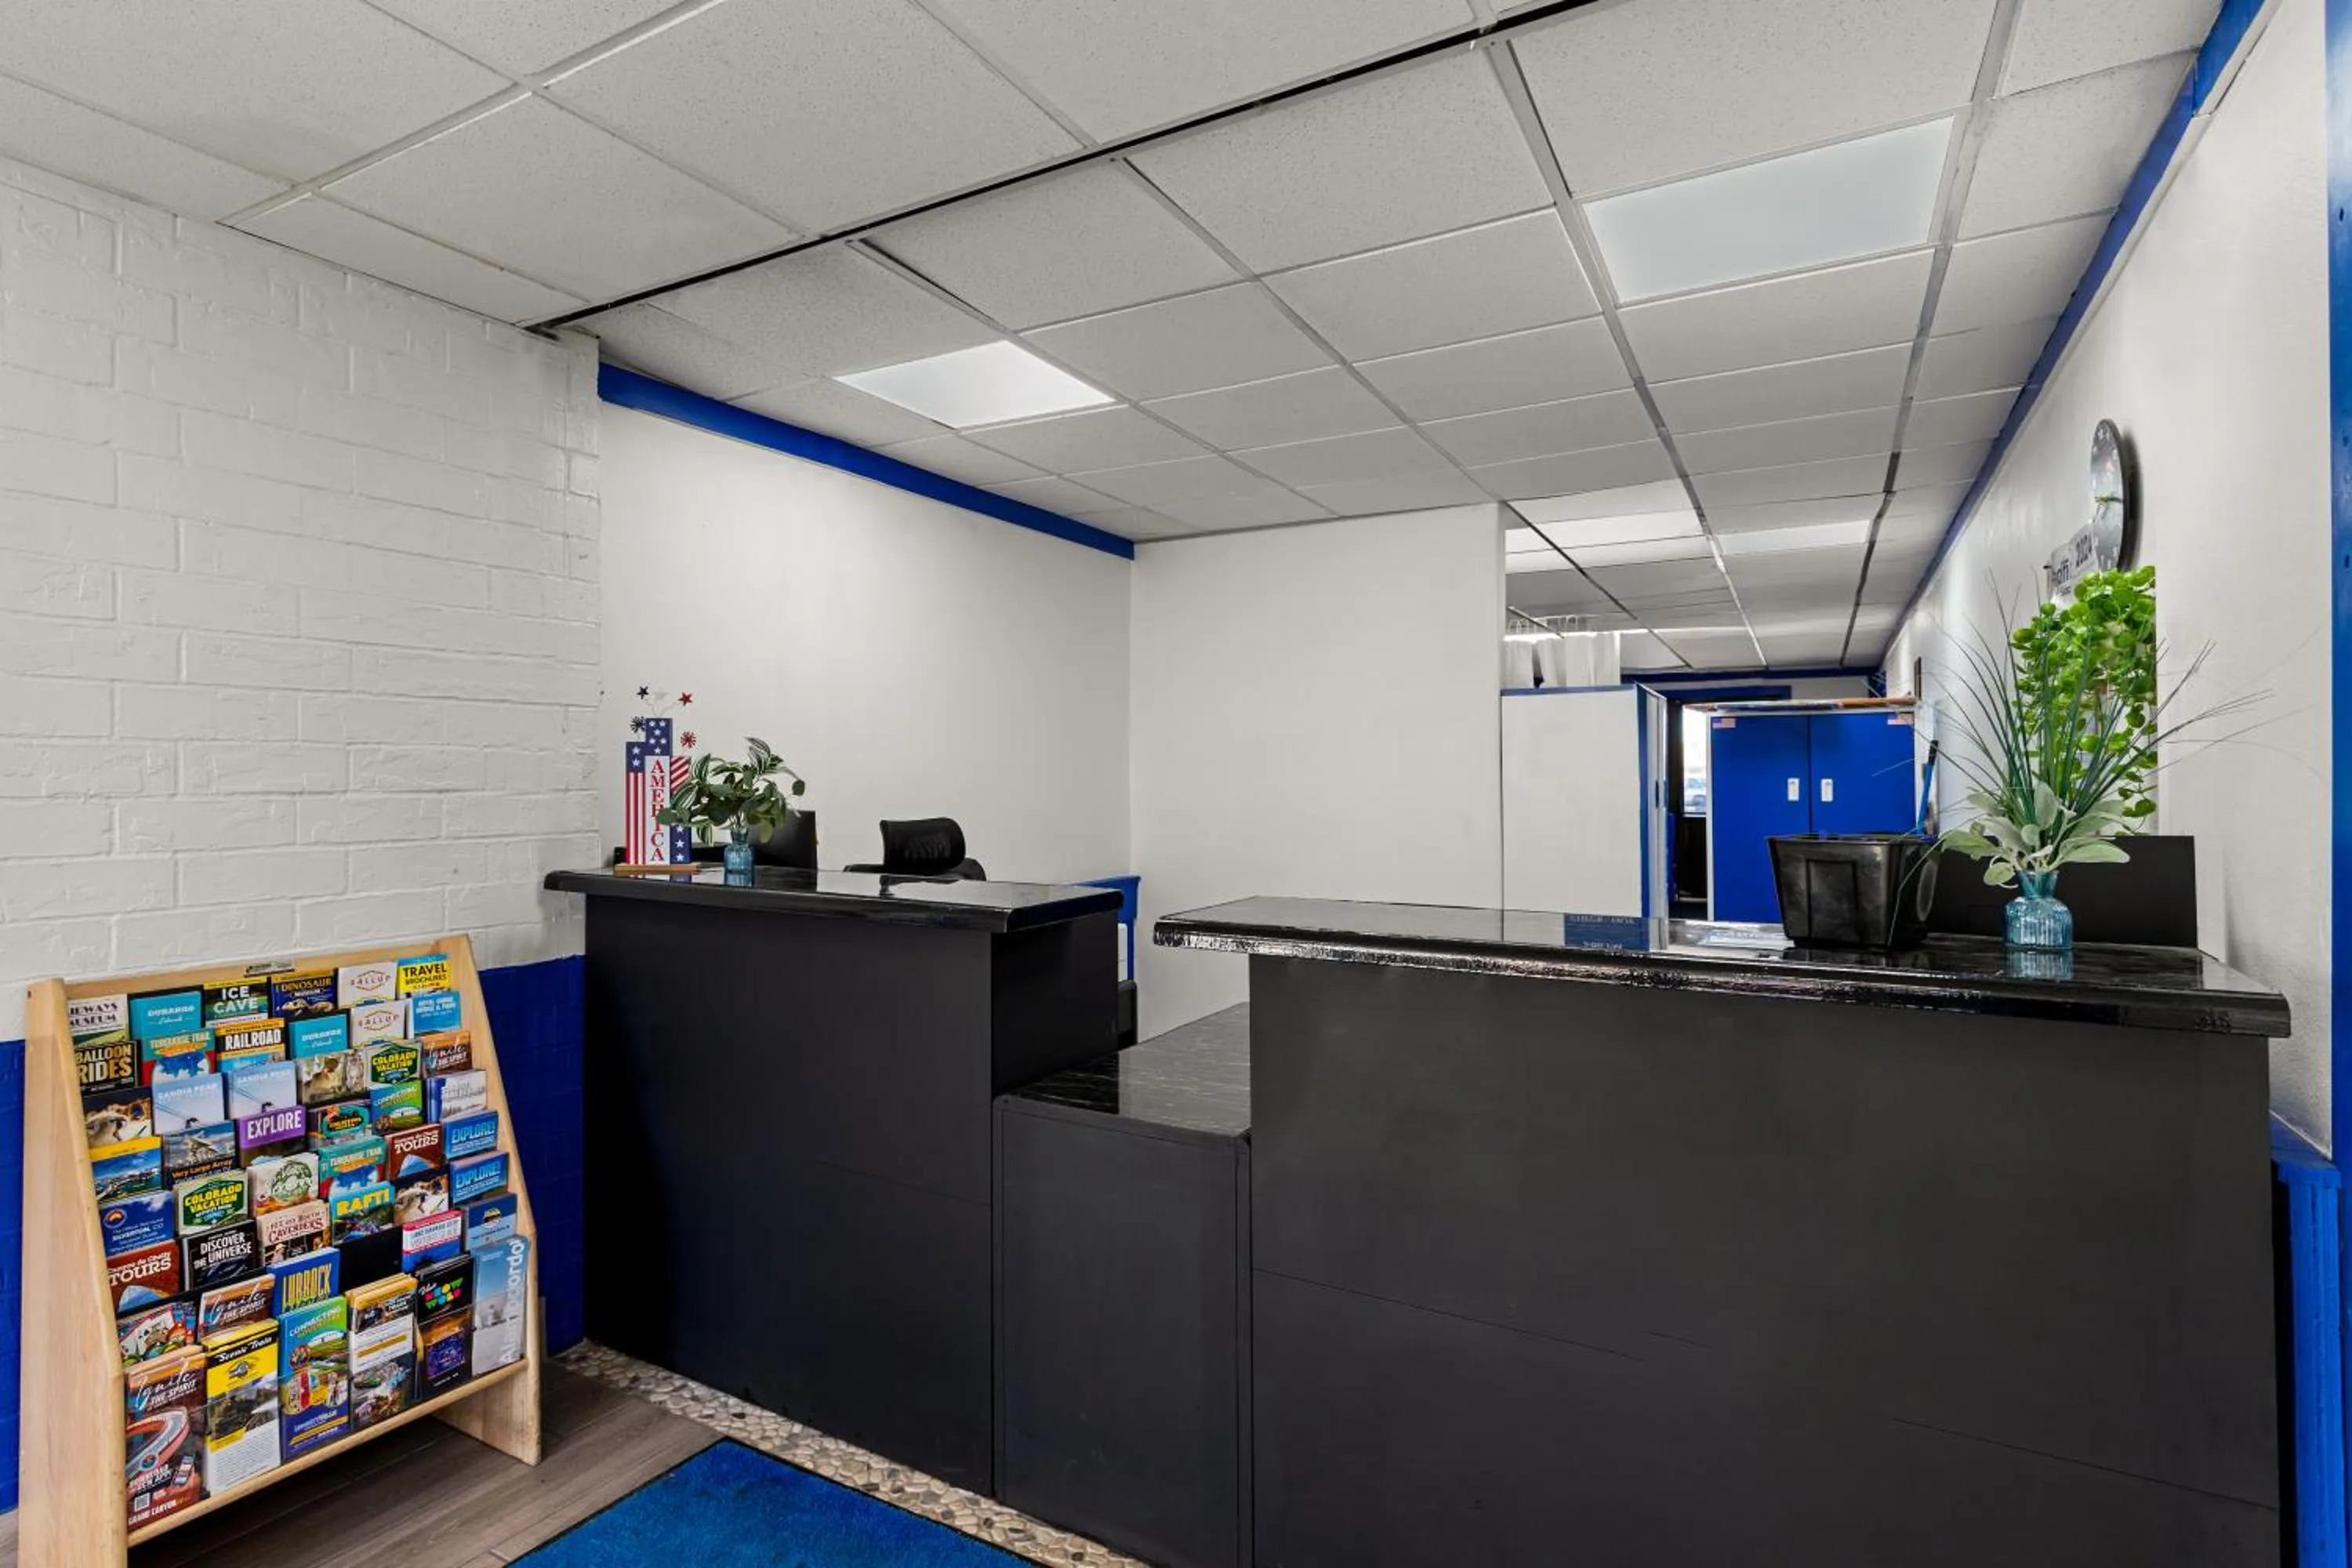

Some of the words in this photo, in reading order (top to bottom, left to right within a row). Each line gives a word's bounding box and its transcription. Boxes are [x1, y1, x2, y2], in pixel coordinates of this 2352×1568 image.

[651, 760, 665, 861] AMERICA
[350, 975, 391, 985] GALLUP
[403, 963, 447, 978] TRAVEL
[405, 974, 447, 985] BROCHURES
[222, 986, 250, 1000] ICE
[281, 978, 331, 992] DINOSAUR
[213, 997, 259, 1014] CAVE
[225, 1029, 281, 1051] RAILROAD
[75, 1044, 132, 1063] BALLOON
[372, 1051, 416, 1065] COLORADO
[78, 1057, 132, 1083] RIDES
[248, 1110, 302, 1140] EXPLORE
[394, 1134, 438, 1154] TOURS
[184, 1183, 242, 1207] COLORADO
[190, 1193, 237, 1213] VACATION
[200, 1232, 245, 1254] DISCOVER
[208, 1242, 252, 1263] UNIVERSE
[109, 1257, 172, 1286] TOURS
